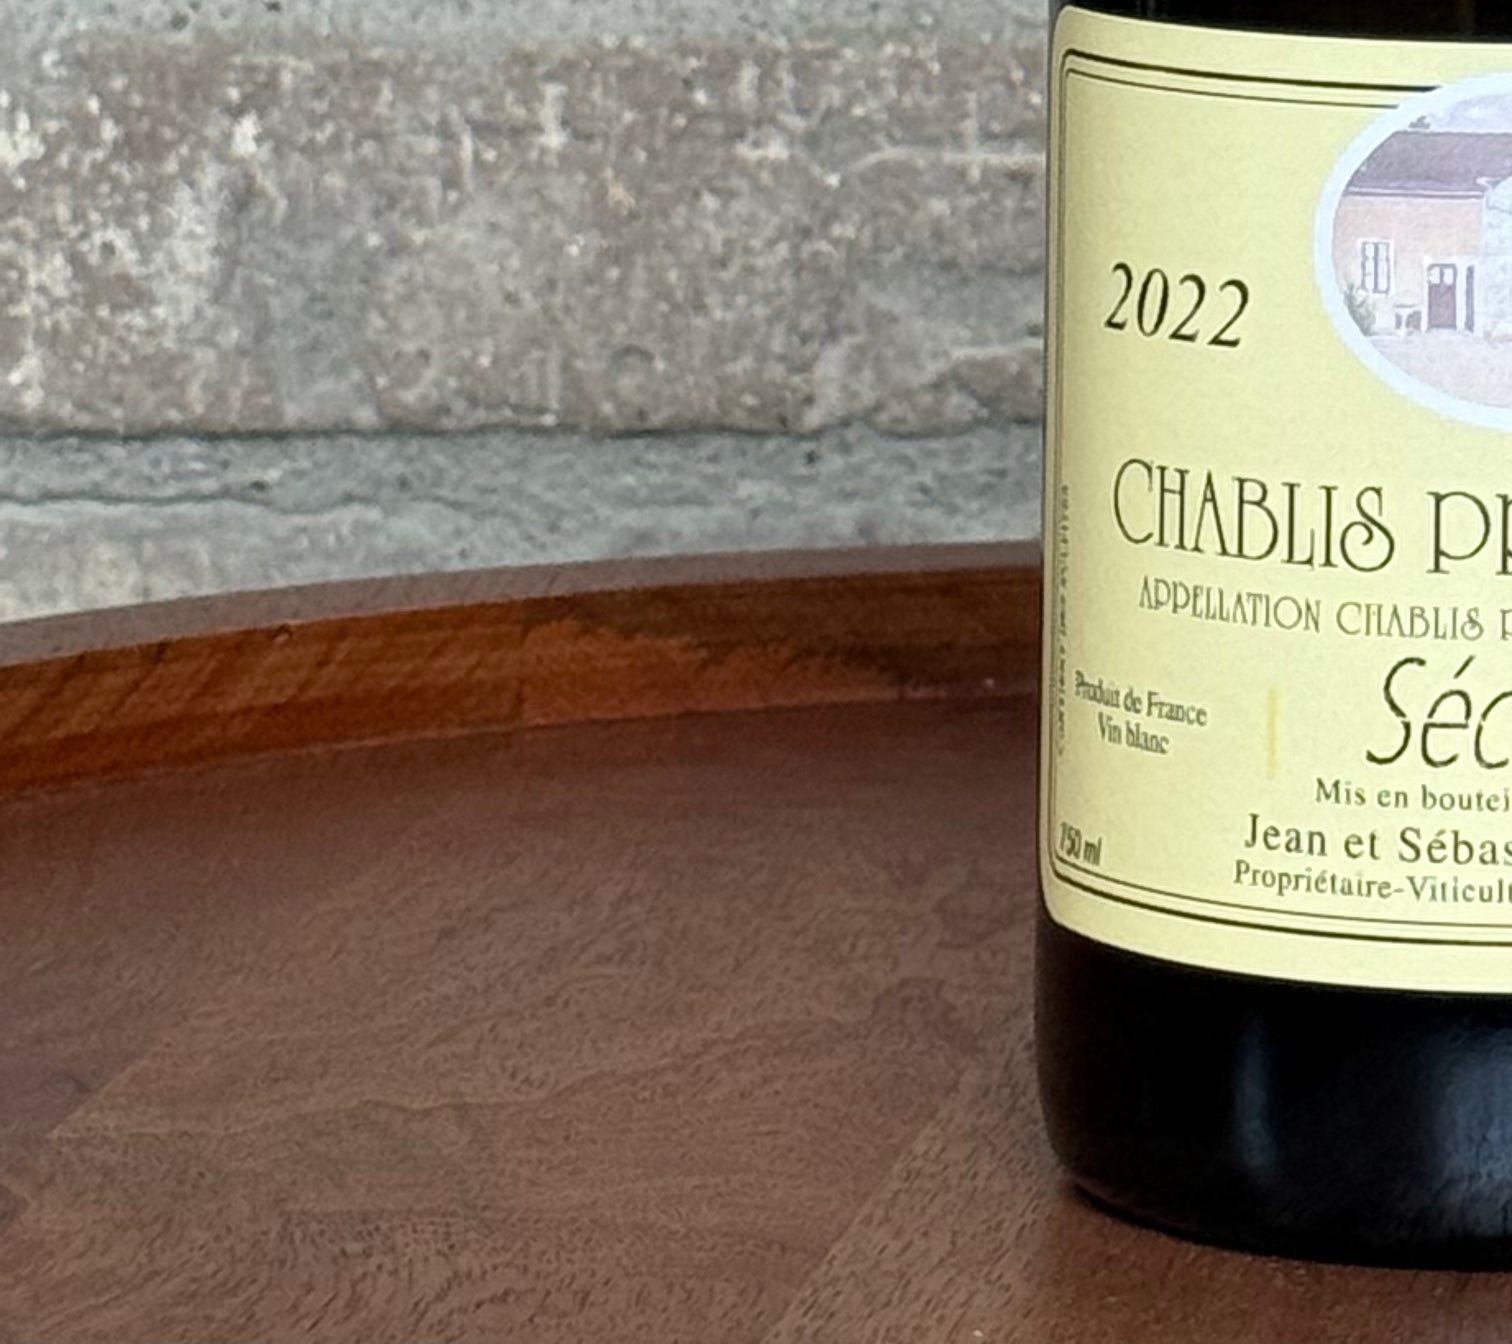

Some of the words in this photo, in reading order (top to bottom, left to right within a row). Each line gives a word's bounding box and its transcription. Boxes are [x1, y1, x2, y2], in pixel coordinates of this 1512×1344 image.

[1104, 262, 1249, 348] 2022
[1113, 458, 1395, 572] CHABLIS
[1138, 574, 1322, 635] APPELLATION
[1336, 601, 1484, 642] CHABLIS
[1123, 687, 1143, 714] de
[1146, 690, 1208, 727] France
[1098, 712, 1122, 744] Vin
[1126, 720, 1170, 754] blanc
[1315, 777, 1367, 806] Mis
[1377, 788, 1409, 809] en
[1083, 836, 1102, 866] ml
[1244, 812, 1327, 857] Jean
[1343, 829, 1381, 861] et
